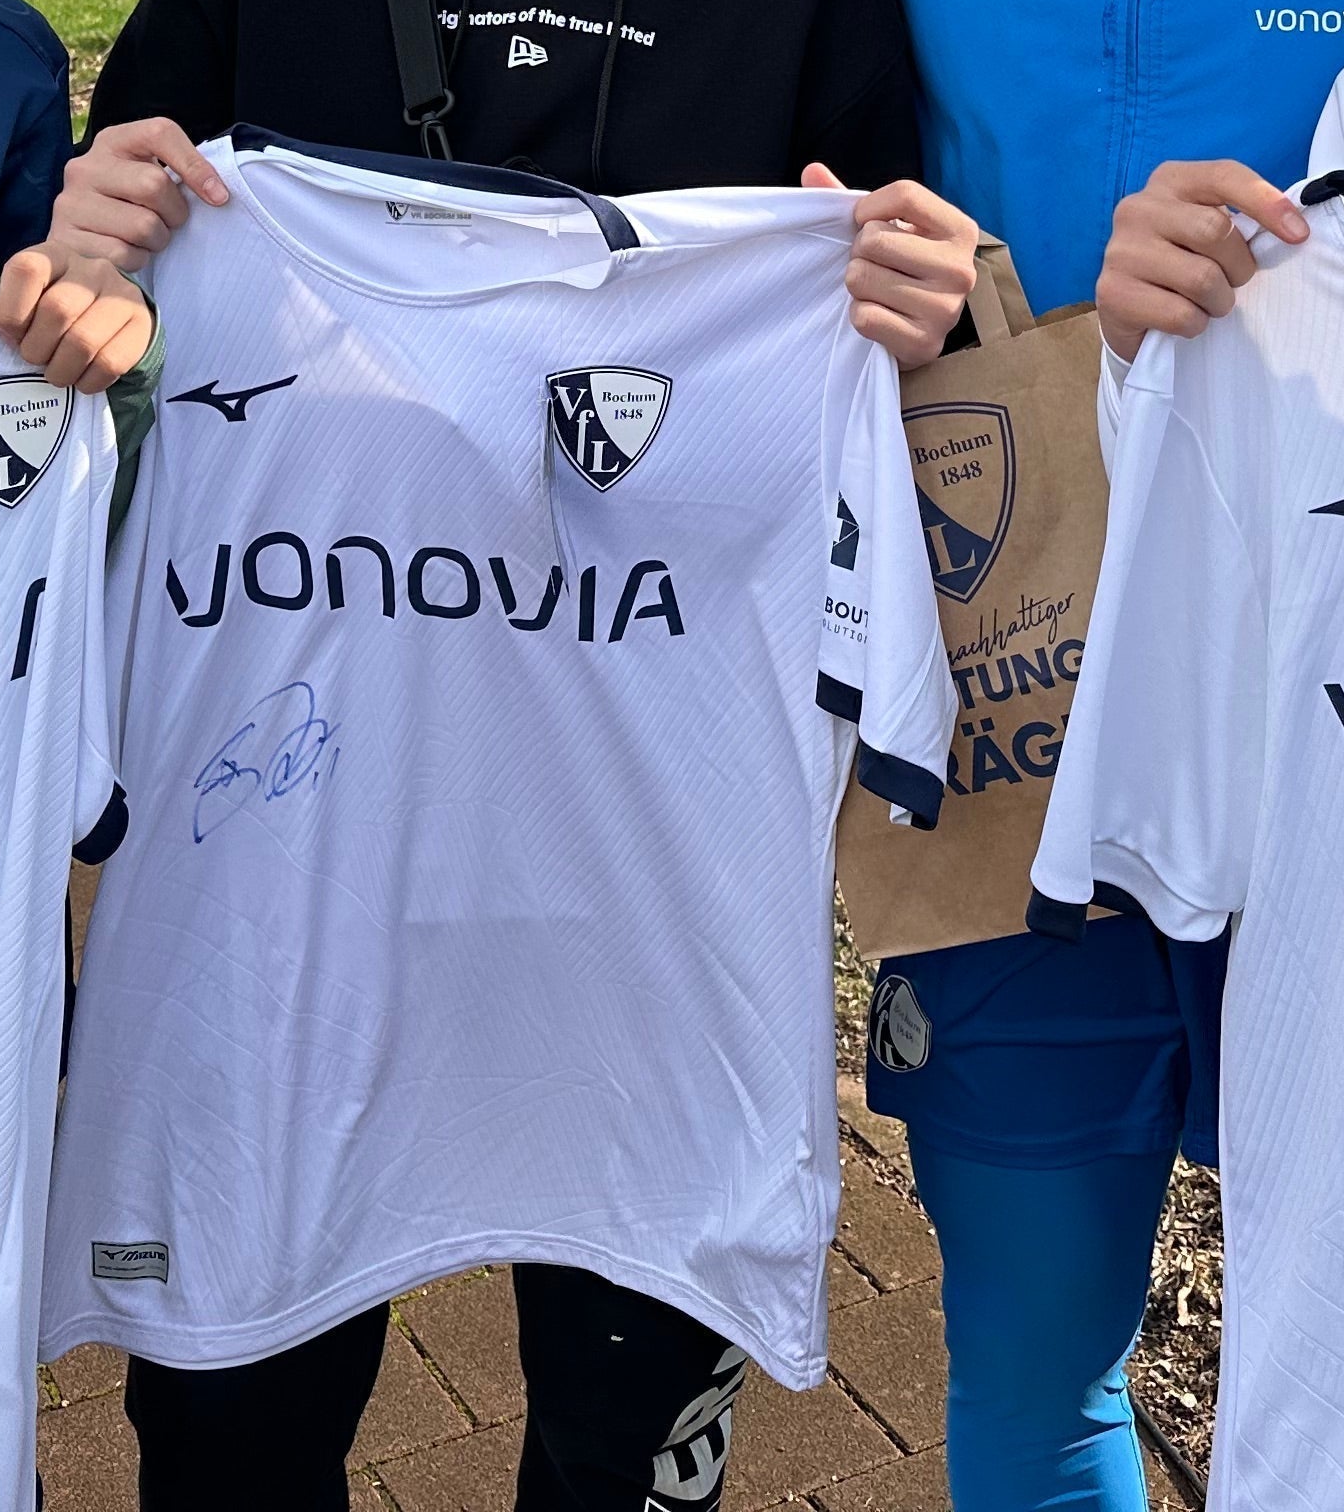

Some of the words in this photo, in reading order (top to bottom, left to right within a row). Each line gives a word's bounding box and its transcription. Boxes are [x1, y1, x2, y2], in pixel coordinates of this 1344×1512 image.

[518, 7, 537, 22] of
[538, 9, 566, 27] the
[569, 16, 604, 34] true
[0, 397, 60, 416] Bochum
[601, 391, 657, 403] Bochum
[614, 408, 644, 420] 1848
[15, 415, 48, 433] 1848
[913, 432, 994, 466] Bochum
[937, 460, 984, 488] 1848
